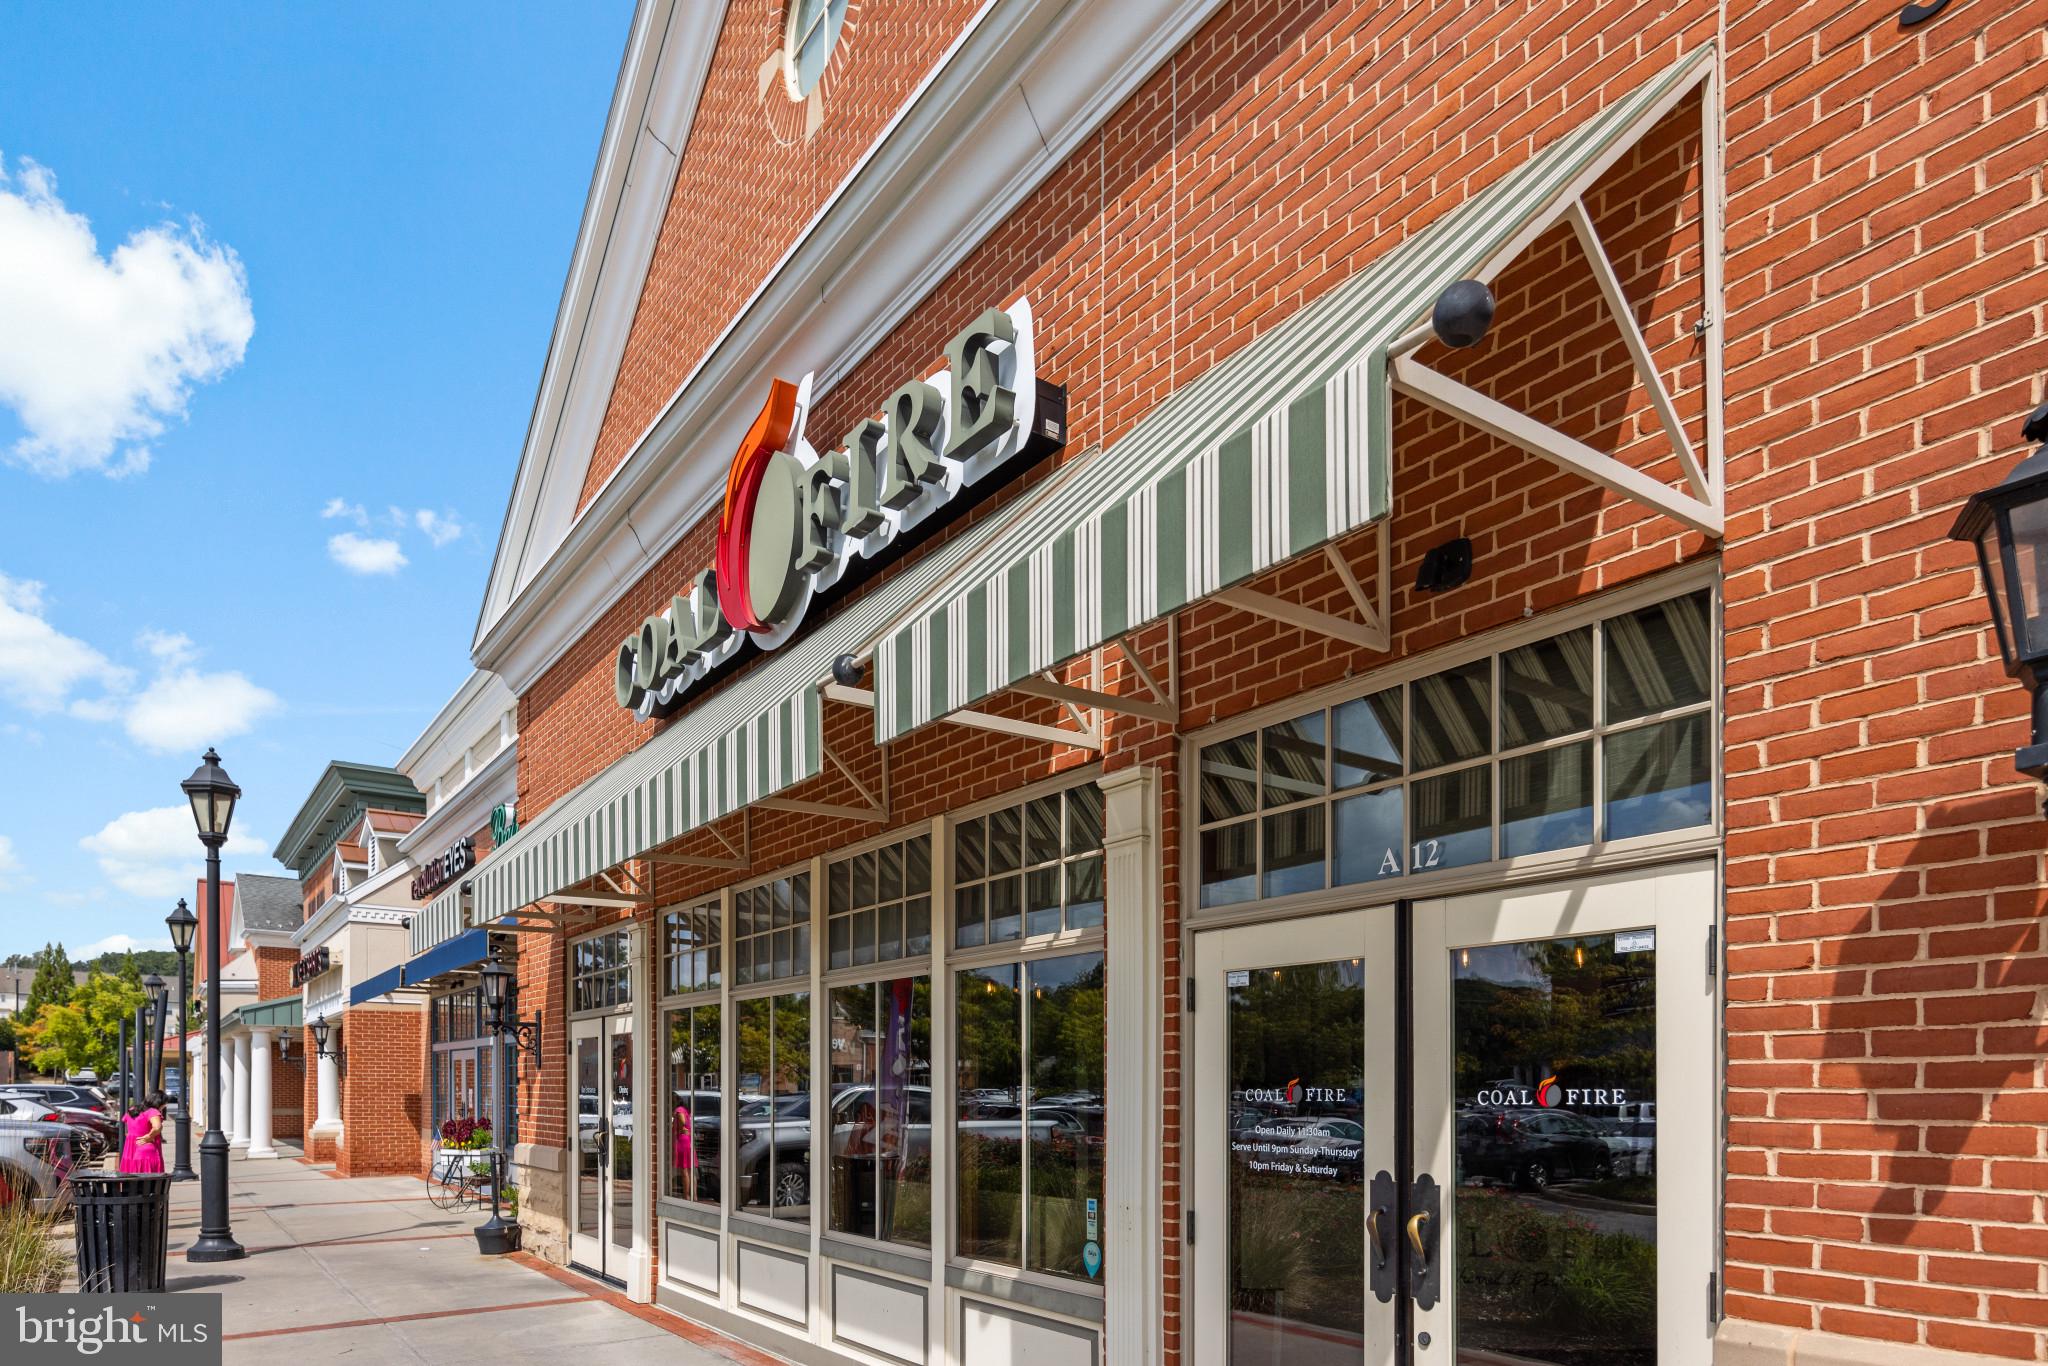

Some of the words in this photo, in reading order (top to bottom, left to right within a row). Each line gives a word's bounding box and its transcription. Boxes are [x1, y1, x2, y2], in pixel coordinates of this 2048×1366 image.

[615, 568, 730, 708] COAL
[796, 306, 1018, 572] FIRE
[1245, 1088, 1284, 1102] COAL
[1305, 1088, 1346, 1102] FIRE
[1477, 1090, 1533, 1106] COAL
[1565, 1088, 1627, 1105] FIRE
[1255, 1125, 1275, 1137] Open
[1276, 1125, 1295, 1138] Daily
[1297, 1127, 1330, 1137] 11:30am
[1231, 1141, 1252, 1151] Serve
[1252, 1142, 1270, 1152] Until
[1271, 1144, 1289, 1155] 9pm
[1249, 1160, 1270, 1171] 10pm
[1270, 1161, 1294, 1174] Friday
[1295, 1164, 1302, 1173] &
[1302, 1165, 1338, 1177] Saturday
